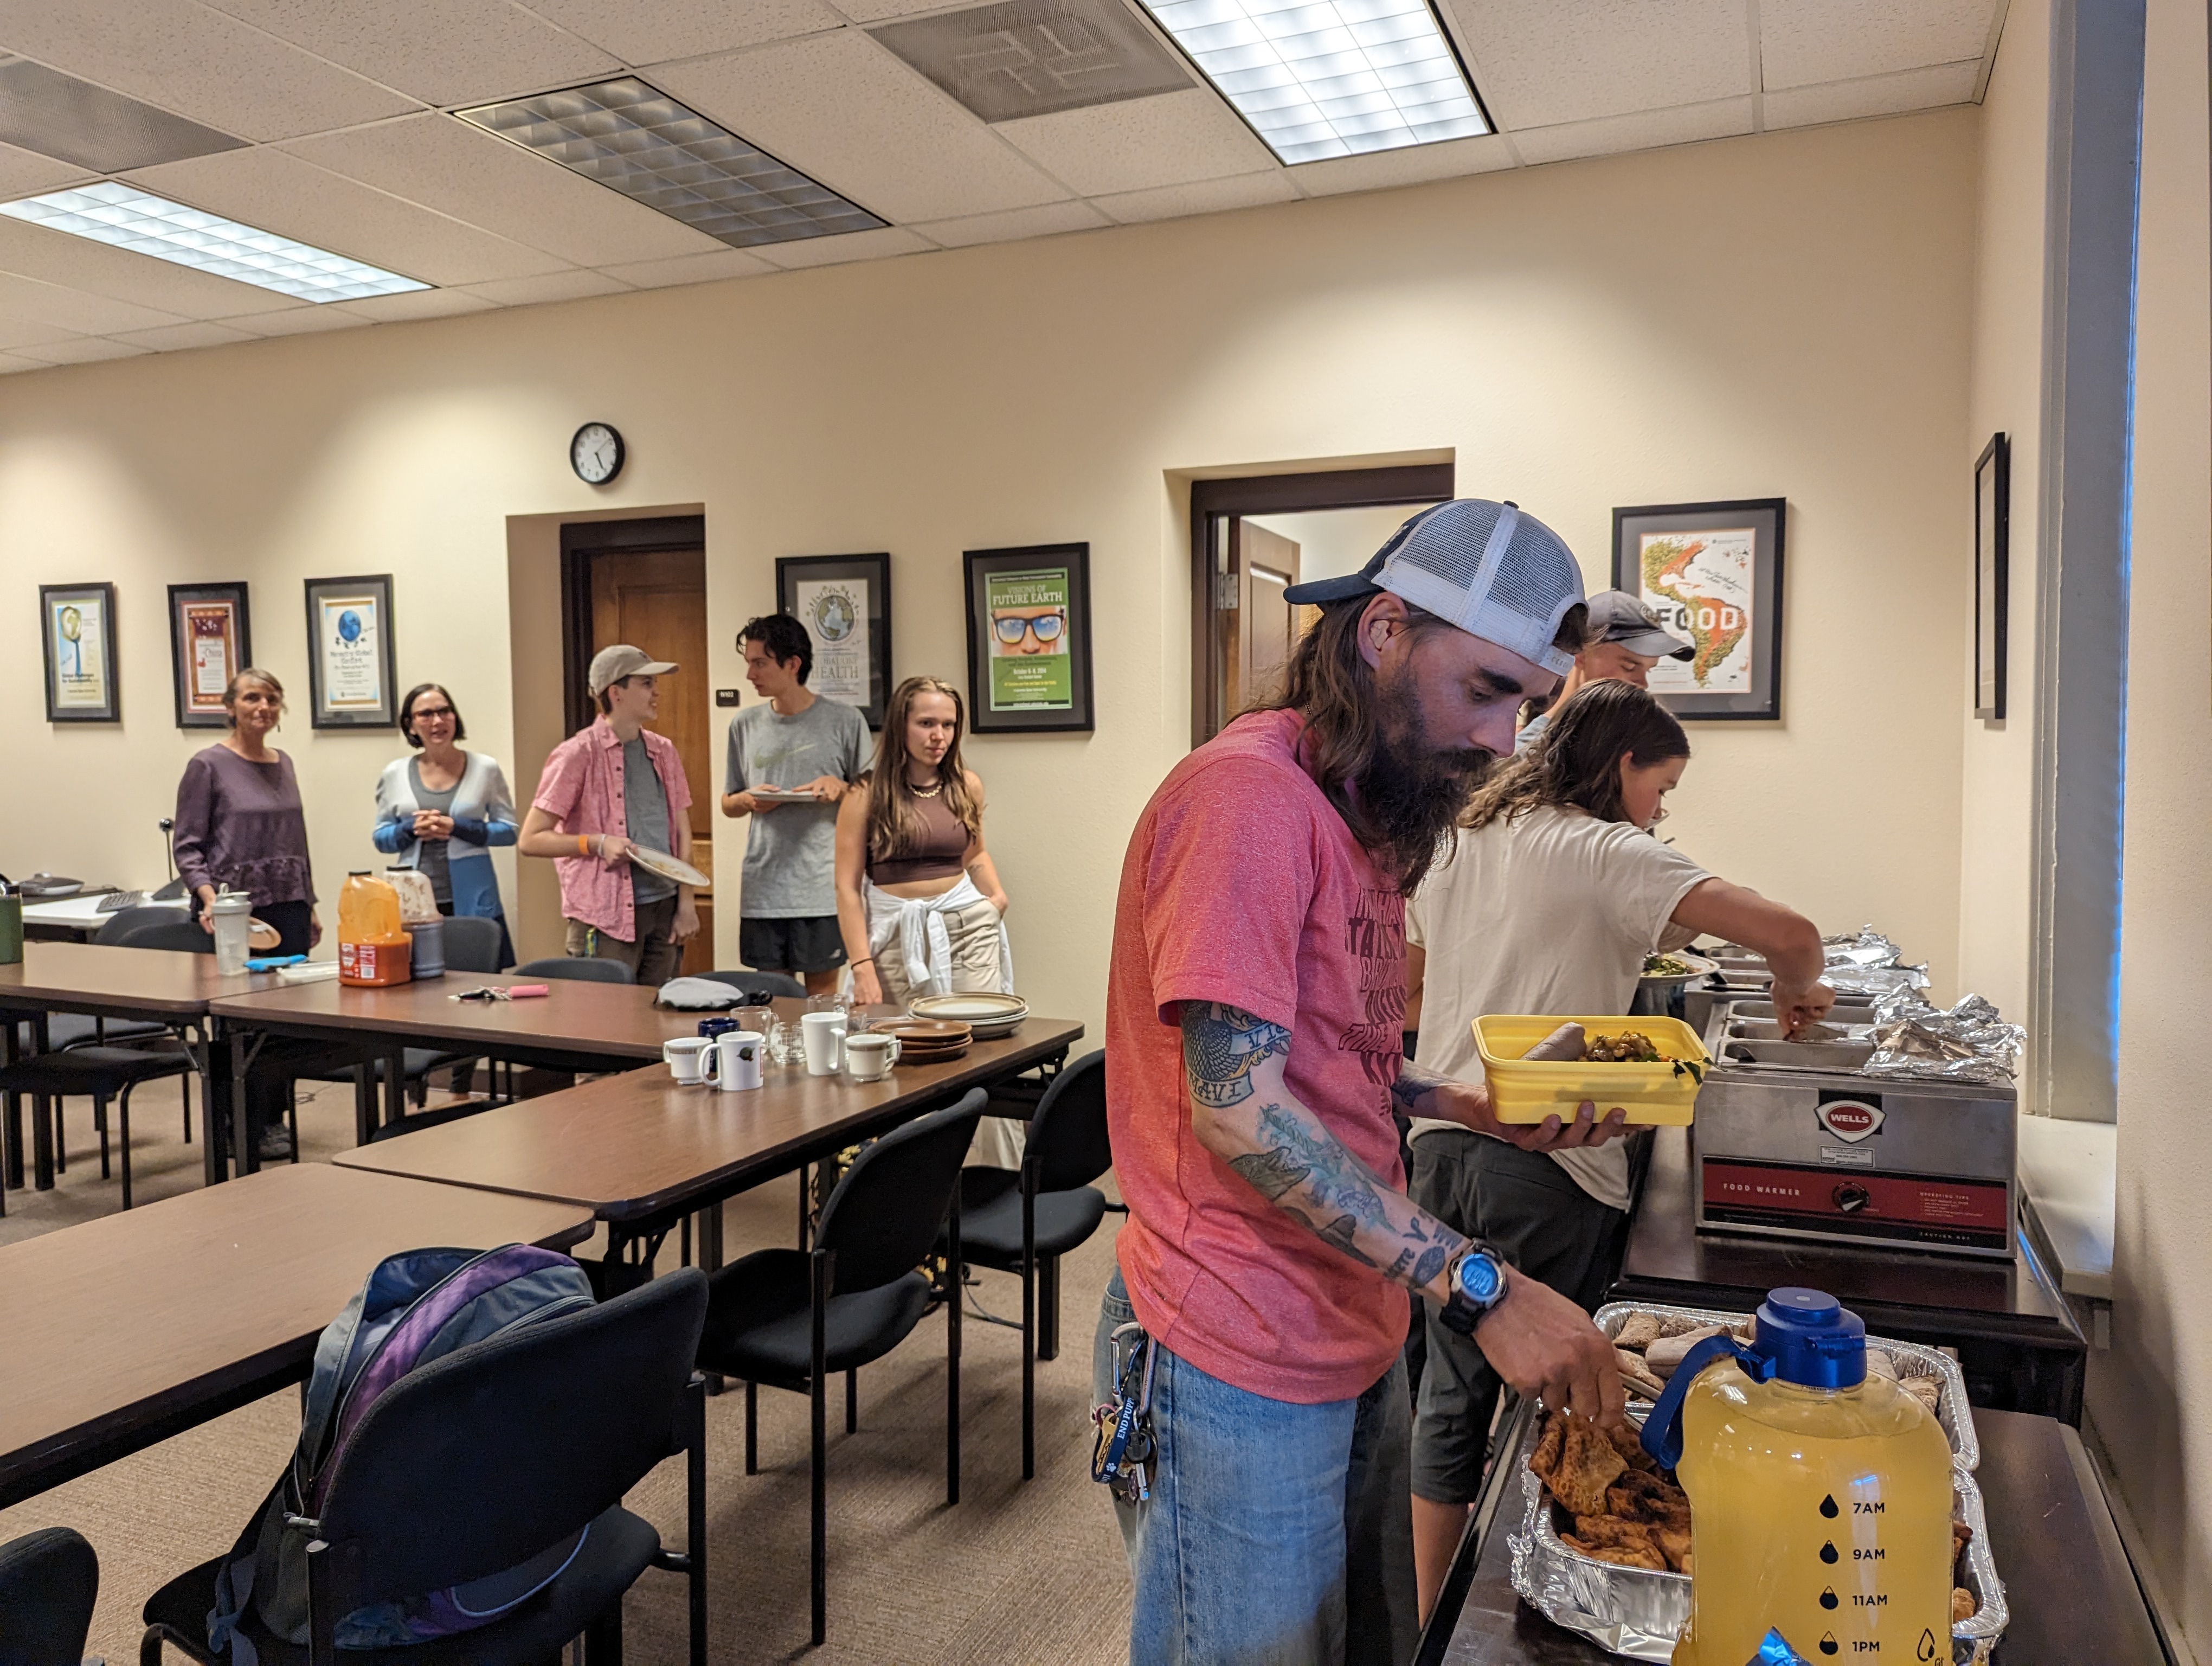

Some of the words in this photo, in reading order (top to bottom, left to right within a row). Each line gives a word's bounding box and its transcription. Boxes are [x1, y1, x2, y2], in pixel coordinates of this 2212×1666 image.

[993, 594, 1028, 605] FUTURE
[1031, 591, 1063, 604] EARTH
[1656, 607, 1738, 631] FOOD
[811, 666, 858, 679] HEALTH
[1830, 1113, 1869, 1124] WELLS
[1723, 1183, 1751, 1191] FOOD
[1757, 1186, 1800, 1196] WARMER
[1117, 1420, 1129, 1439] END
[1853, 1502, 1885, 1514] 7AM
[1853, 1548, 1885, 1560] 9AM
[1852, 1594, 1887, 1606] 11AM
[1852, 1641, 1880, 1652] 1PM
